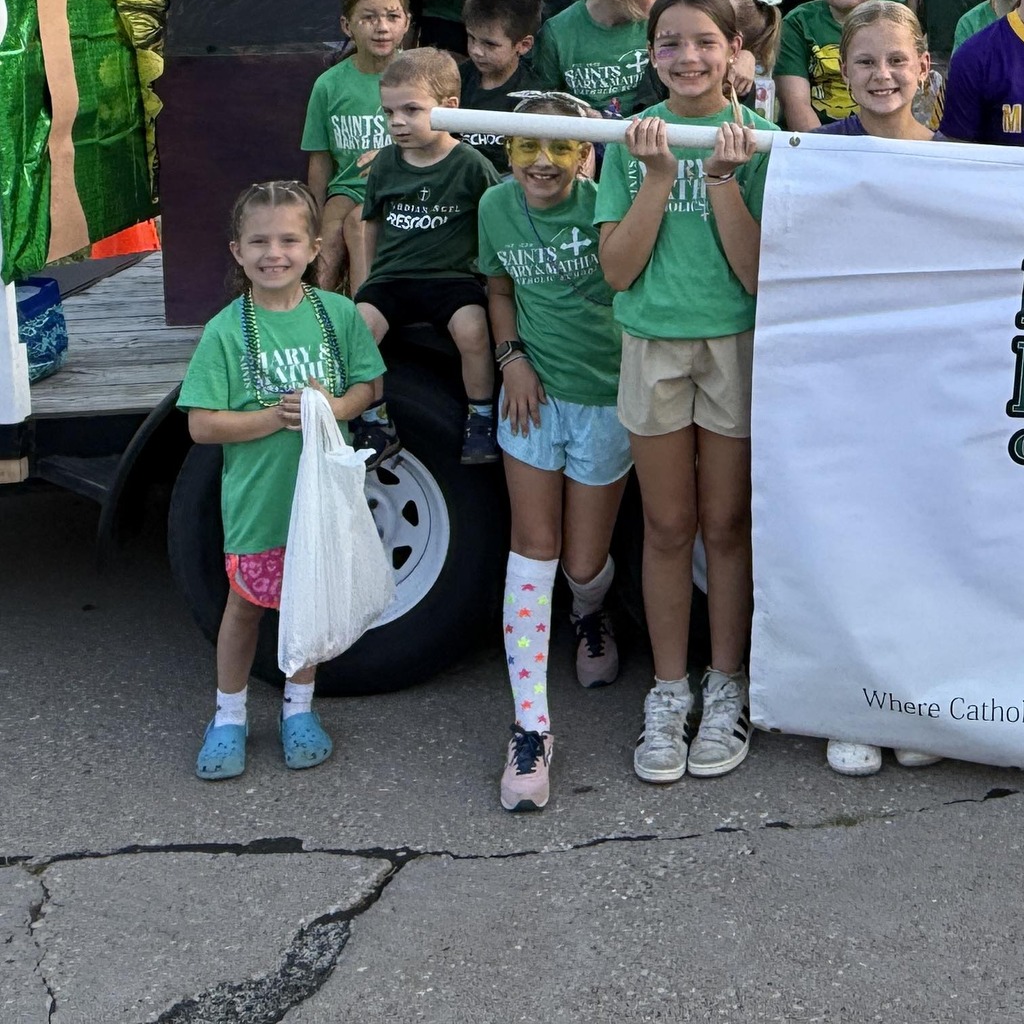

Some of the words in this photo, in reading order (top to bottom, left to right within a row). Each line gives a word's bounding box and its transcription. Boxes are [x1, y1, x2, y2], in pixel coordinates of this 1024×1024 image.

[331, 115, 384, 136] SAINTS
[497, 246, 557, 266] SAINTS
[863, 687, 941, 718] Where
